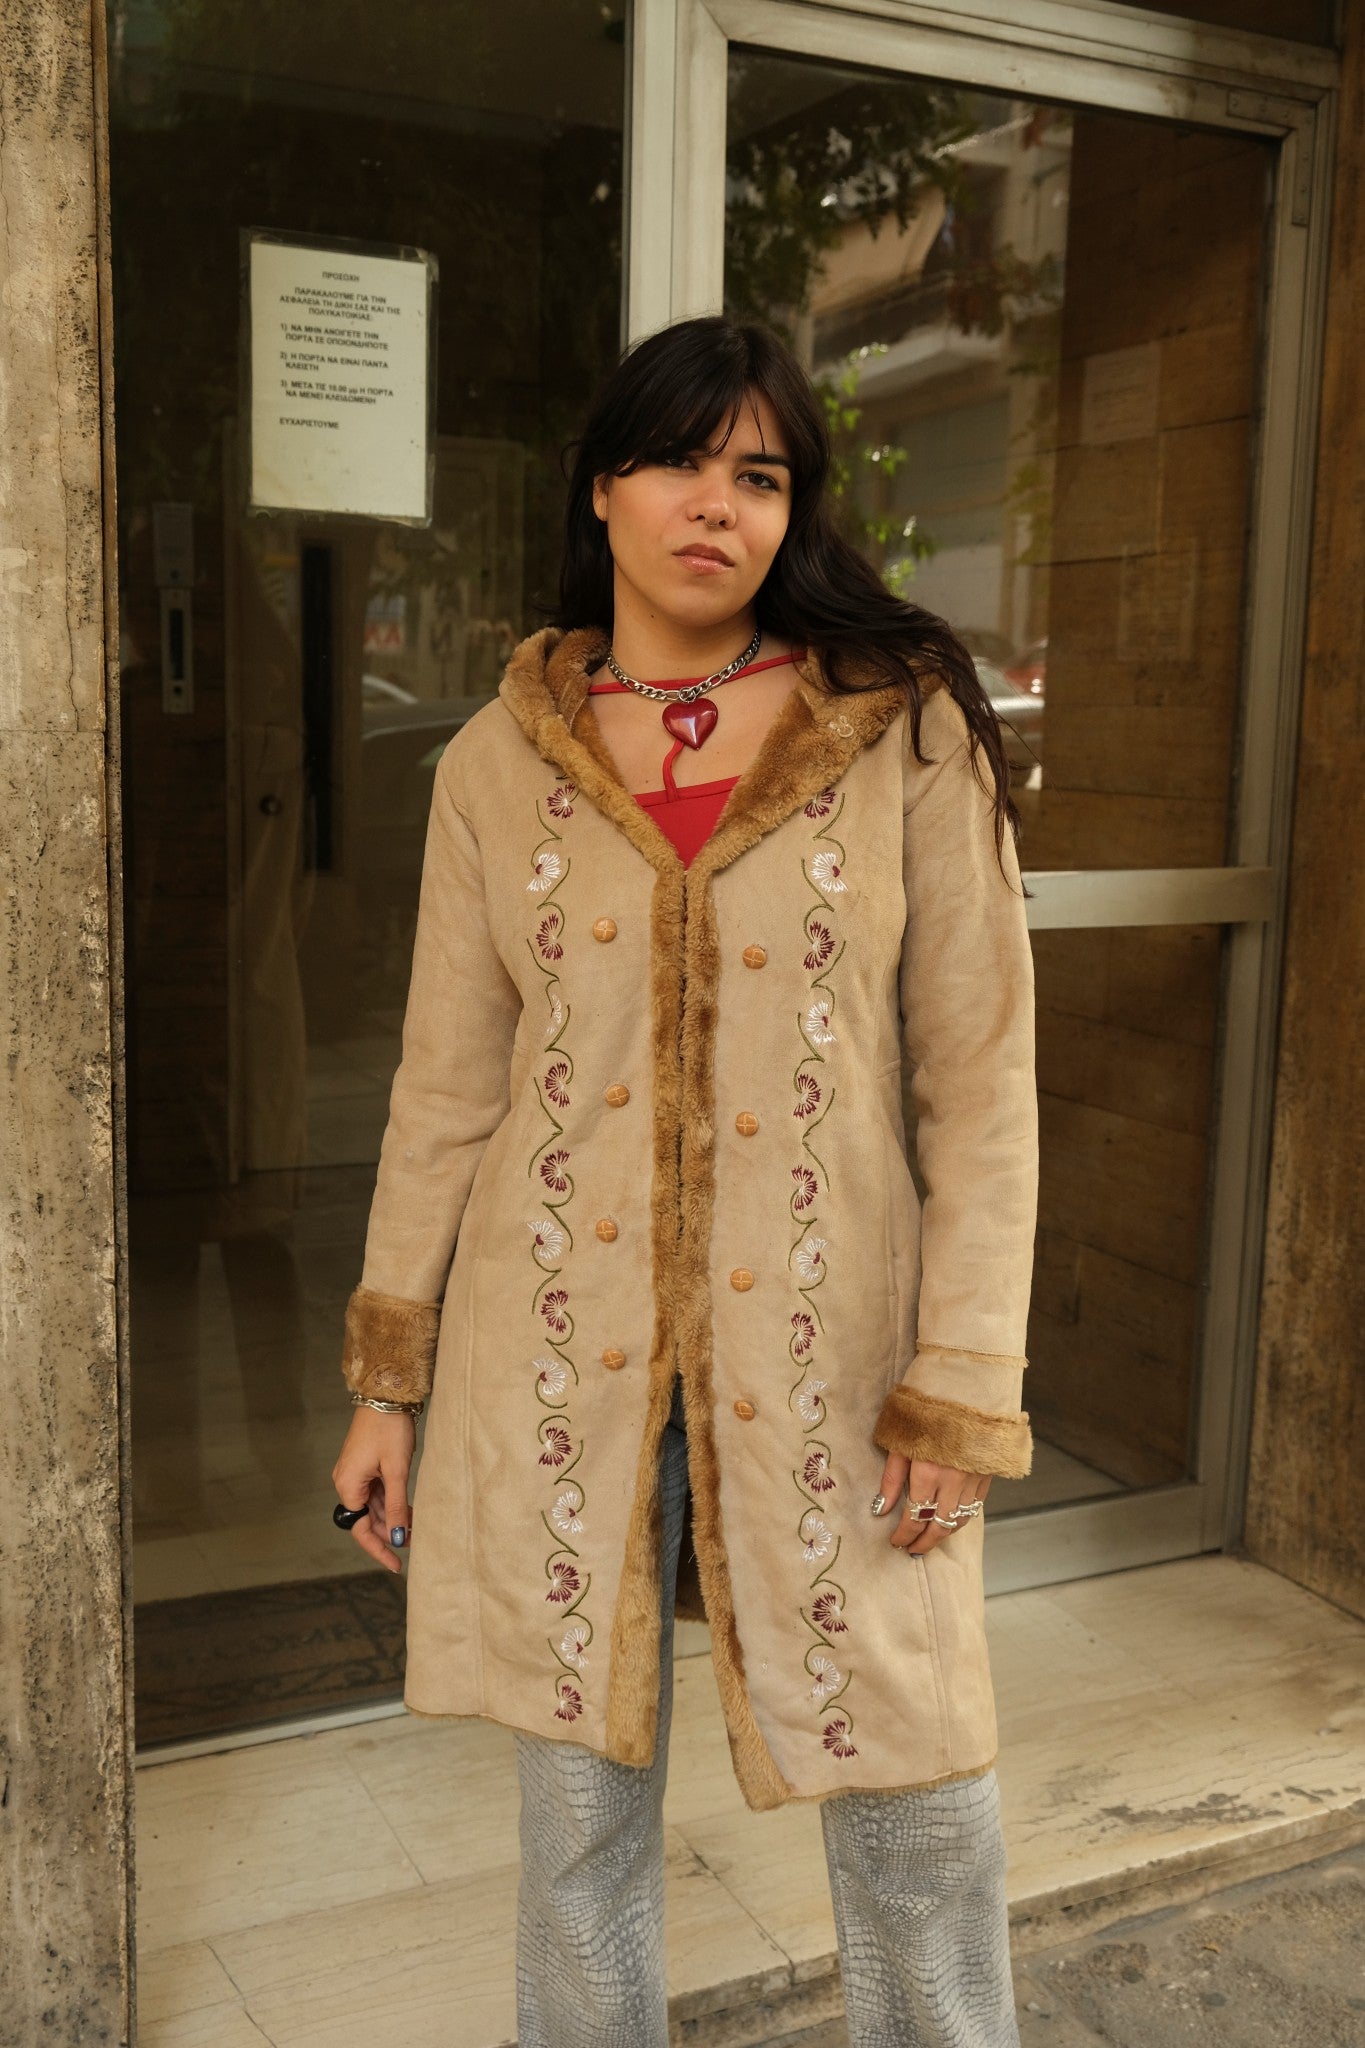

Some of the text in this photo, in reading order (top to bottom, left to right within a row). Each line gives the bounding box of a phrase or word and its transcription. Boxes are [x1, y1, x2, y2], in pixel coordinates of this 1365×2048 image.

[295, 287, 386, 304] ΠΑΡΑΚΑΛΟΥΜΕ ΓΙΑ ΤΗΝ
[280, 296, 320, 305] ΑΣΦΑΛΕΙΑ
[355, 303, 368, 311] ΣΑΣ
[387, 307, 400, 315] ΤΗΣ
[286, 333, 313, 343] ΠΟΡΤΑ
[304, 325, 322, 333] ΜΗΝ
[364, 332, 379, 340] ΤΗΝ
[299, 353, 325, 363] ΠΟΡΤΑ
[340, 357, 360, 366] ΕΙΝΑΙ
[362, 359, 388, 368] ΠΑΝΤΑ
[291, 381, 313, 389] ΜΕΤΑ
[315, 382, 327, 391] ΤΙΣ
[367, 388, 394, 397] ΠΟΡΤΑ
[299, 391, 324, 400] ΜΕΝΕΙ
